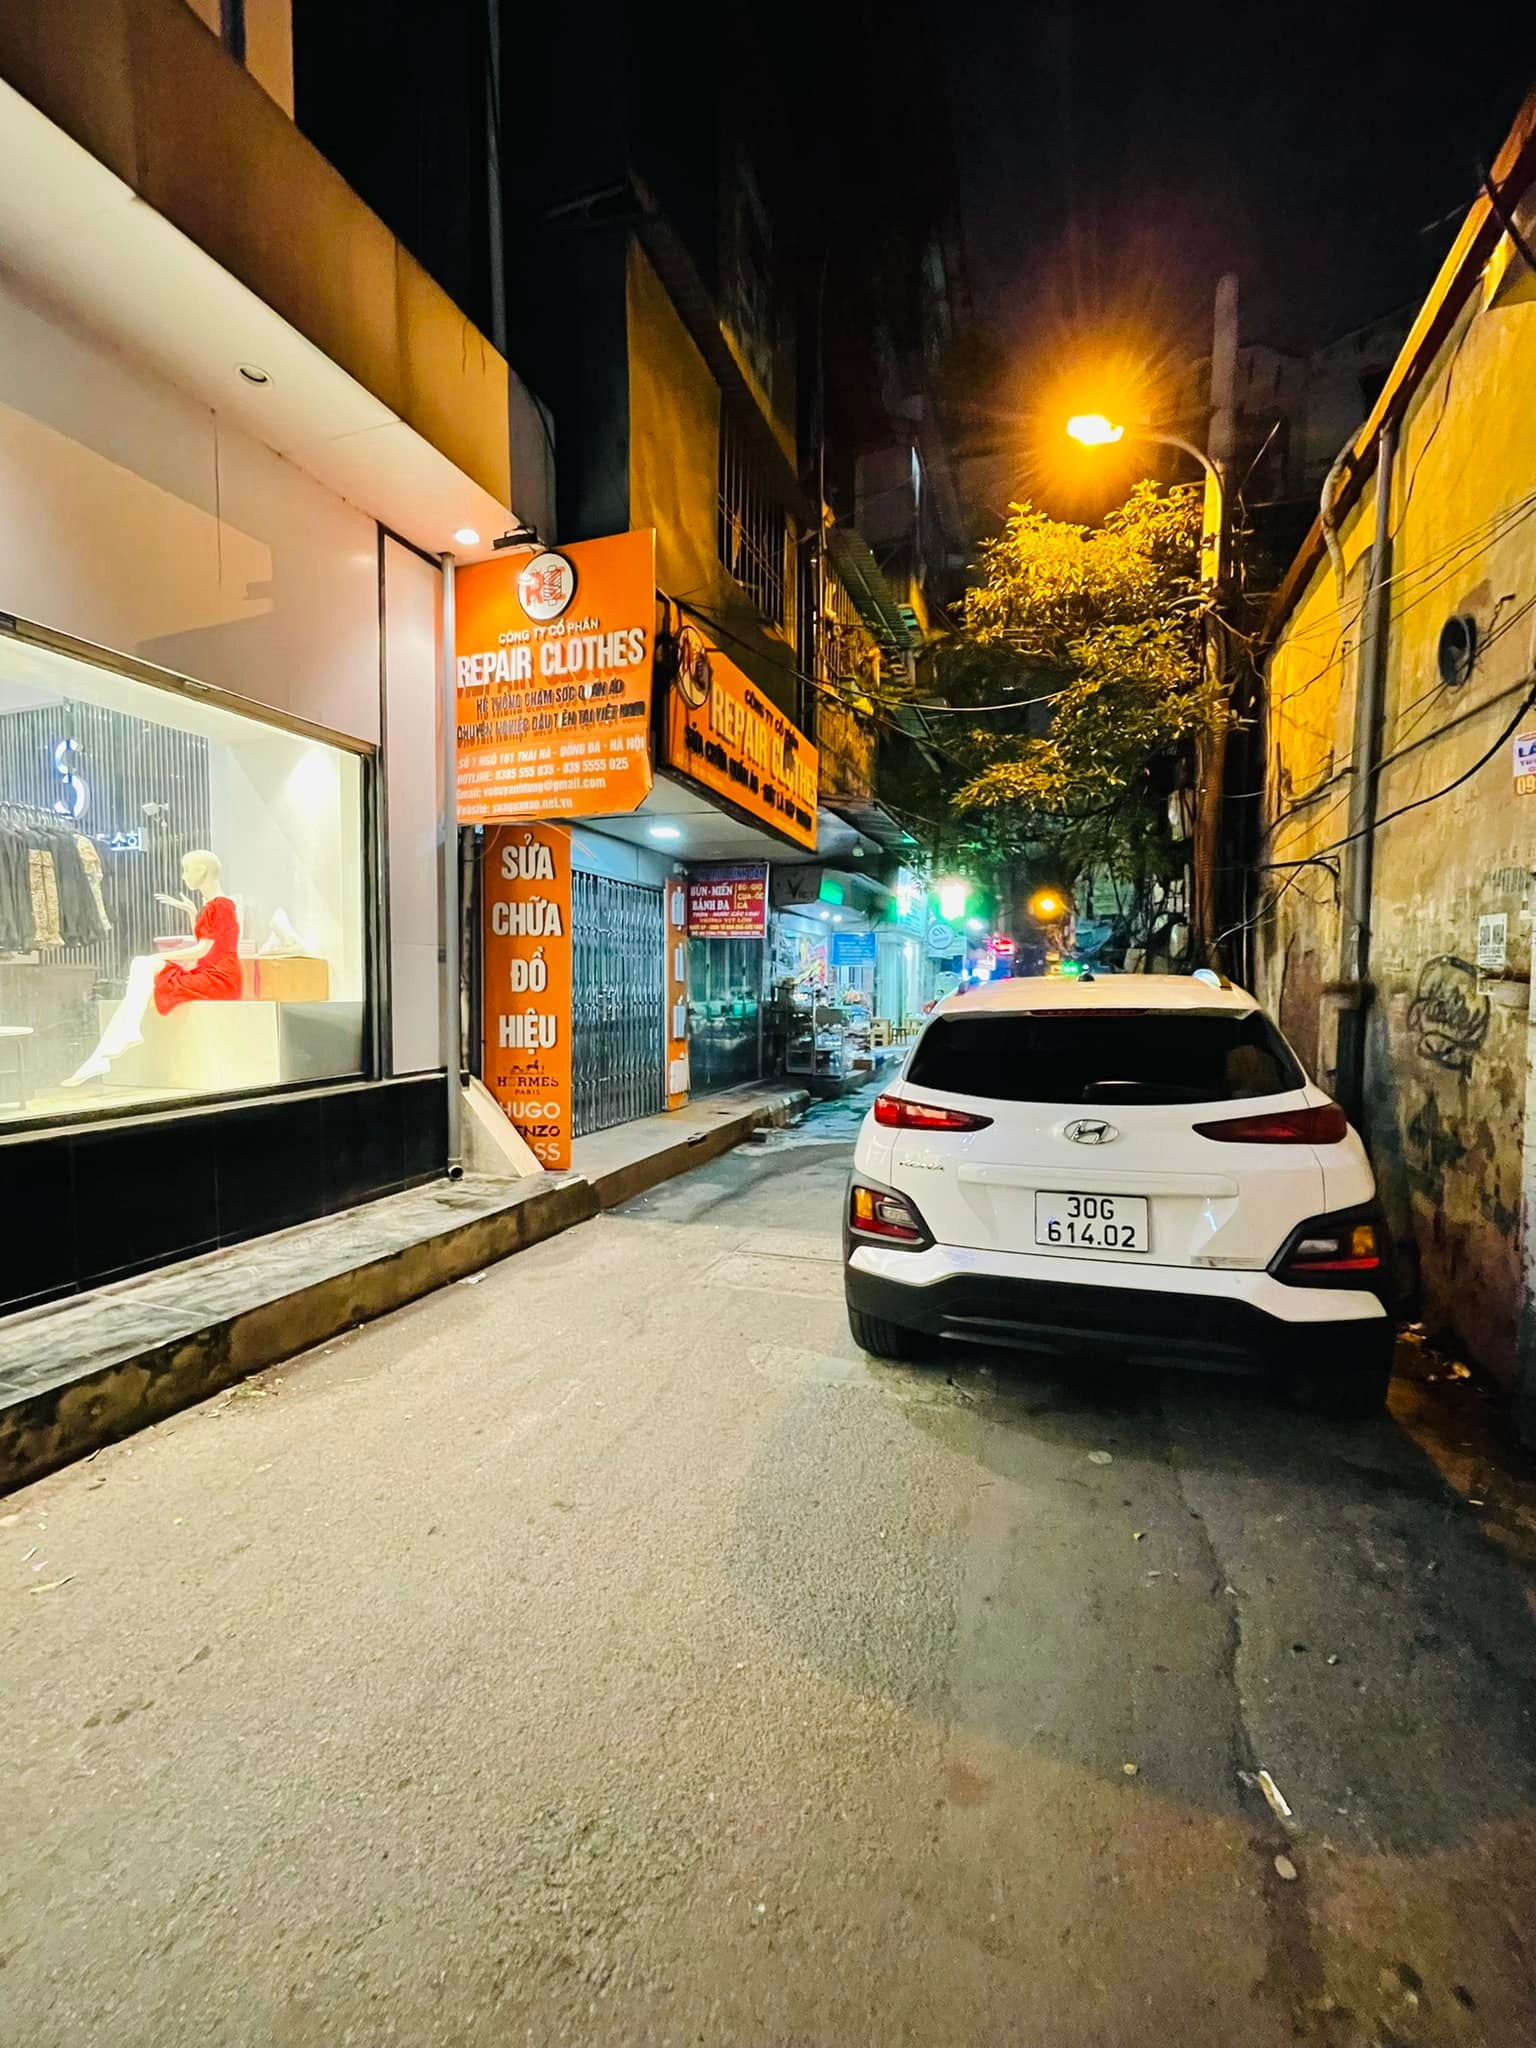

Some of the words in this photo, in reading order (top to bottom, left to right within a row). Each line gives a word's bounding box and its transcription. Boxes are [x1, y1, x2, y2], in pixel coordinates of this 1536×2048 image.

[533, 626, 547, 639] TY
[457, 645, 532, 688] REPAIR
[540, 627, 645, 676] CLOTHES
[610, 737, 624, 752] HÀ
[710, 680, 768, 771] REPAIR
[501, 832, 555, 880] SỬA
[492, 895, 563, 937] CHỮA
[510, 945, 547, 992] ĐỒ
[498, 1007, 557, 1055] HIỆU
[500, 1101, 561, 1119] HUGO
[1067, 1196, 1114, 1220] 30G
[1047, 1220, 1136, 1248] 614.02
